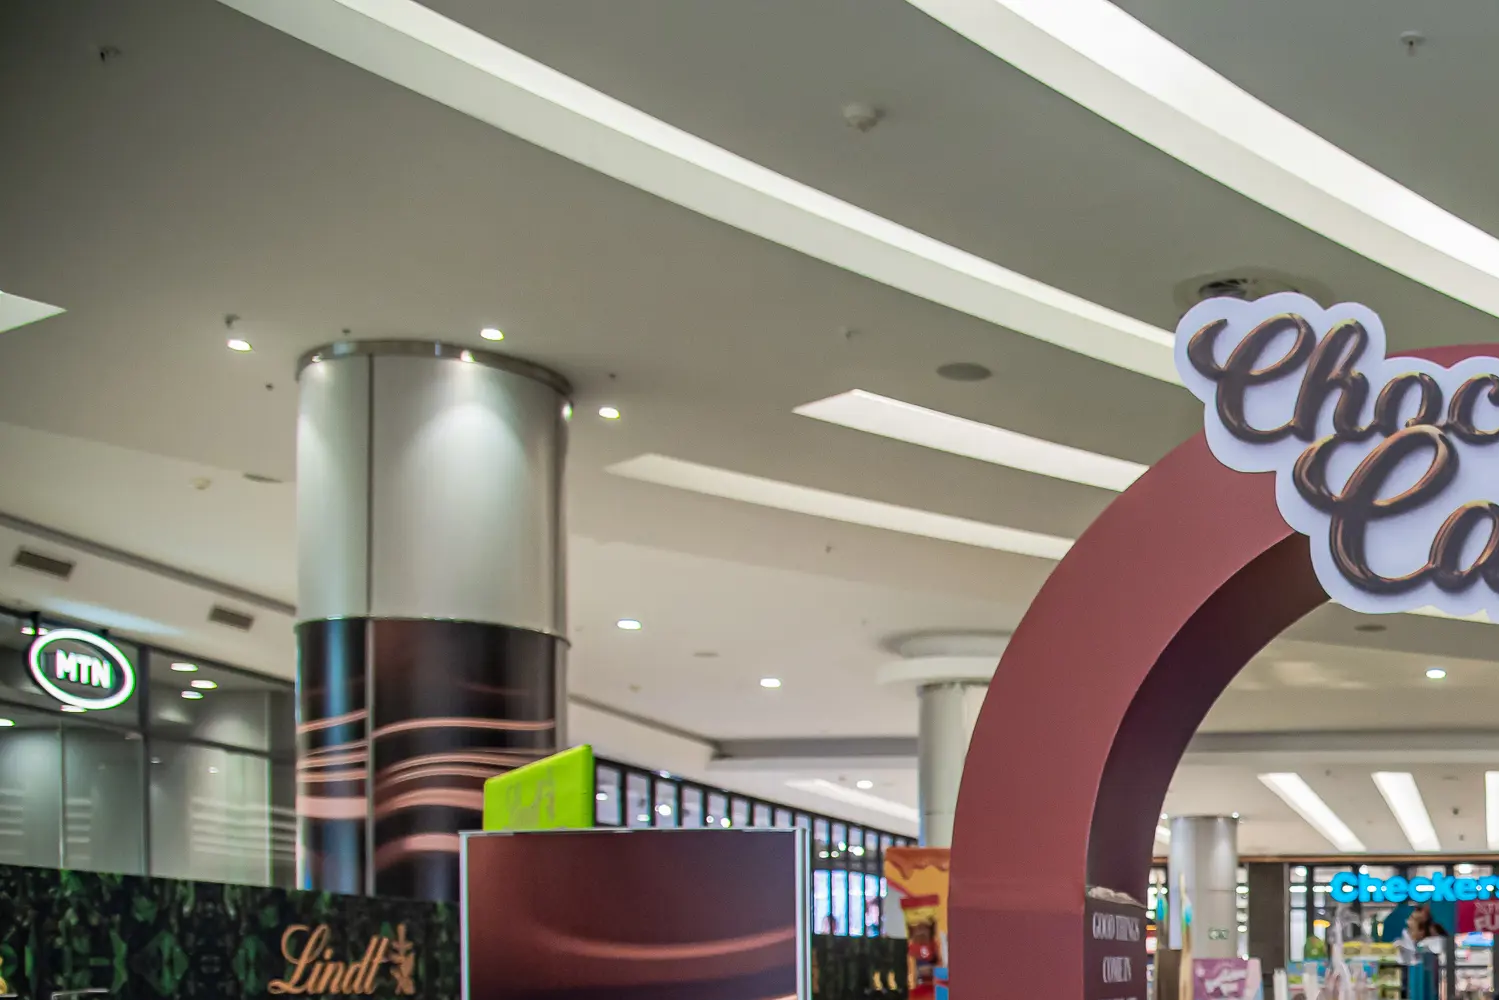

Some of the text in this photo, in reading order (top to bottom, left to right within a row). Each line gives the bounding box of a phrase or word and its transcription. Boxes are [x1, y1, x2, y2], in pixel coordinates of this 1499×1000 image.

[55, 648, 113, 689] MTN
[1093, 911, 1115, 940] GOOD
[267, 924, 389, 995] Lindt
